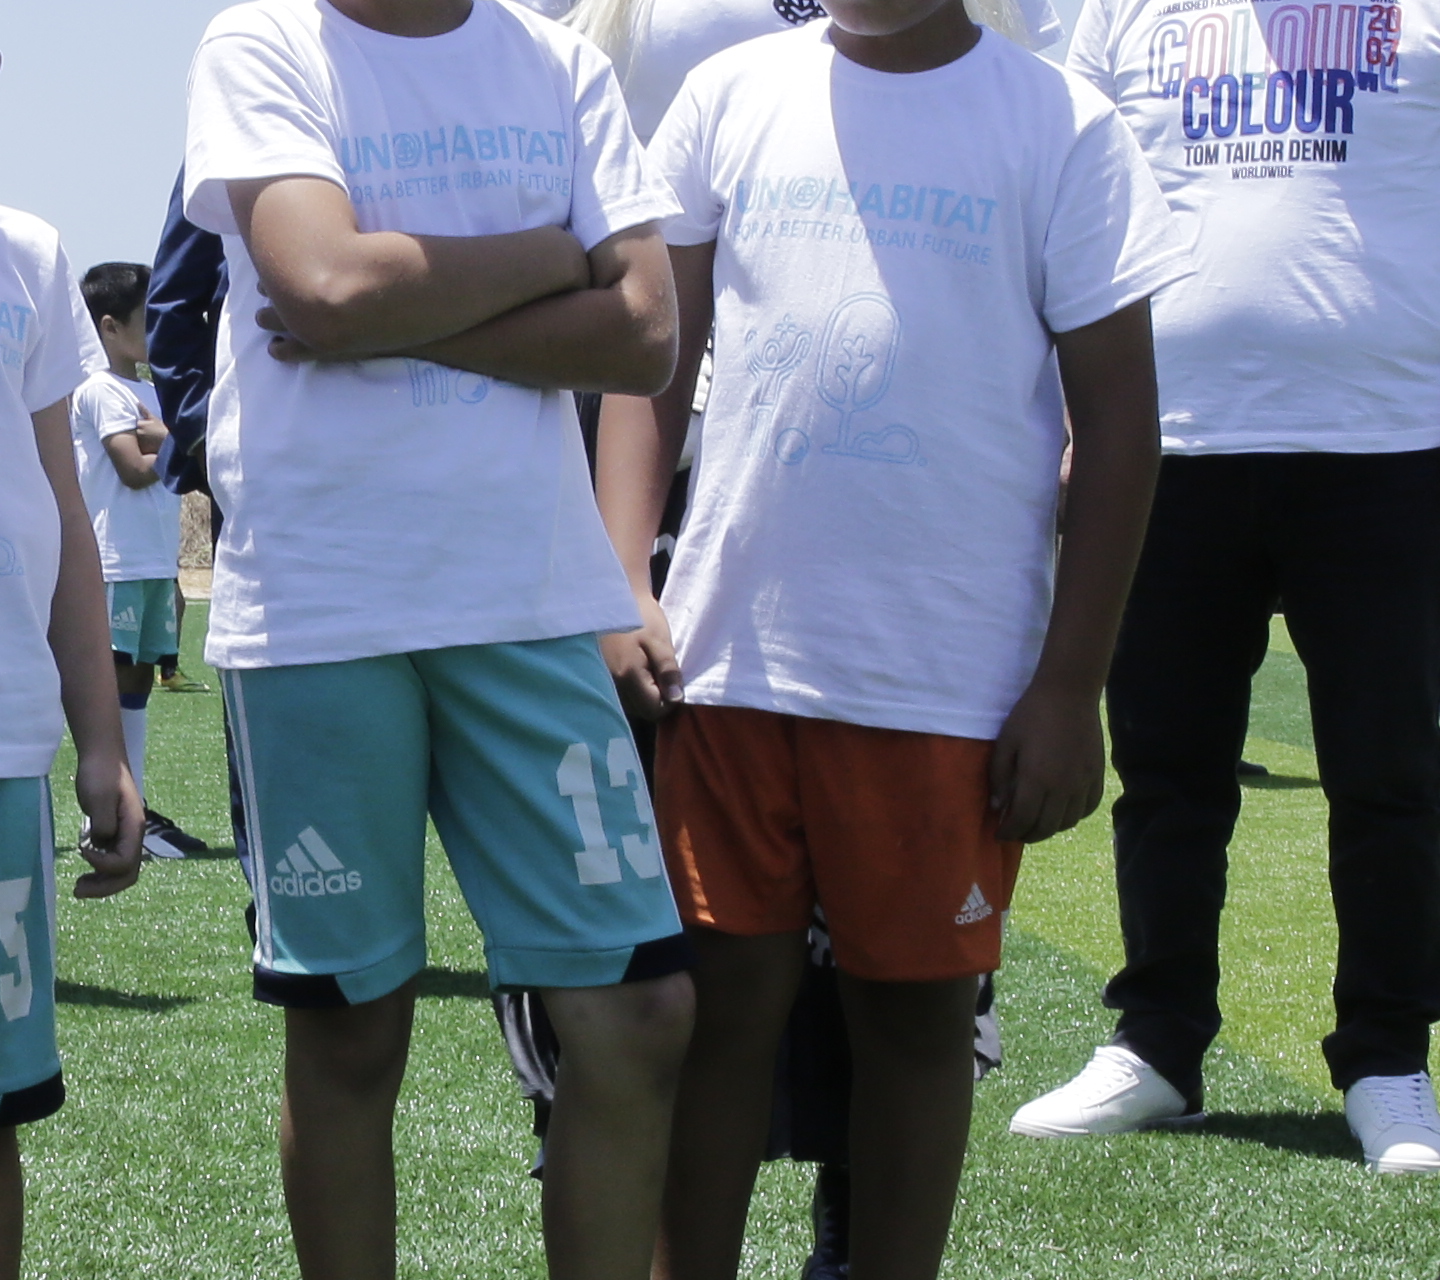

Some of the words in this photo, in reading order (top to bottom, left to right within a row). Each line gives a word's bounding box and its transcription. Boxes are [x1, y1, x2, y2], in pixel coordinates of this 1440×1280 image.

[1366, 4, 1402, 32] 20
[1182, 68, 1354, 140] COLOUR
[423, 124, 567, 167] HABITAT
[1183, 144, 1219, 166] TOM
[1224, 140, 1284, 164] TAILOR
[1289, 139, 1347, 163] DENIM
[1231, 165, 1295, 180] WORLDWIDE
[351, 184, 374, 204] OR
[380, 183, 393, 201] A
[396, 175, 450, 198] BETTER
[825, 177, 998, 235] HABITAT
[763, 221, 774, 238] A
[778, 220, 843, 242] BETTER
[849, 226, 917, 250] URBAN
[922, 233, 993, 266] FUTURE
[556, 737, 662, 885] 13
[270, 868, 362, 896] adidas
[955, 904, 992, 924] adidas
